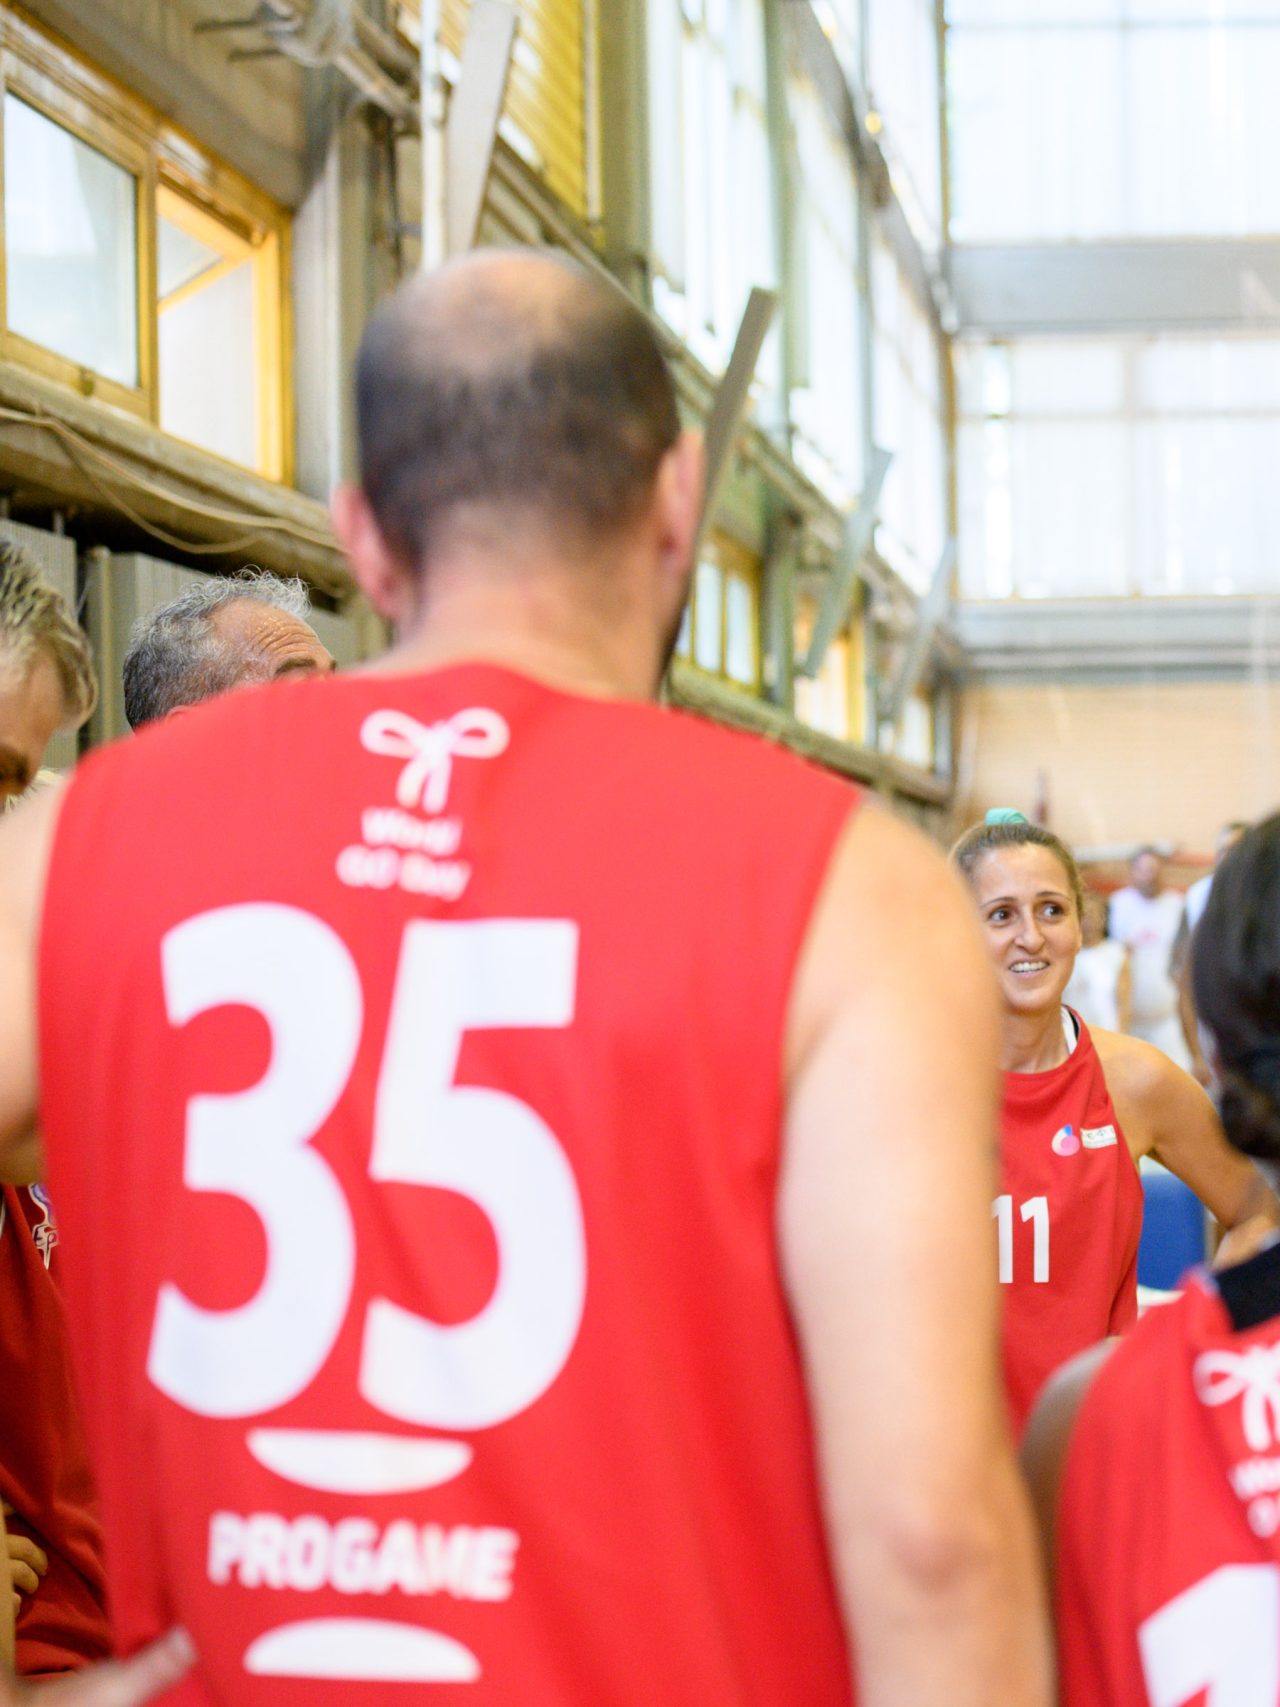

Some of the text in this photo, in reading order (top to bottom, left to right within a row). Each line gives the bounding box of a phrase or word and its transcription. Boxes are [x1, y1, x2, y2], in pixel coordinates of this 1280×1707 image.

[147, 902, 587, 1431] 35
[991, 1194, 1050, 1283] 11
[208, 1511, 520, 1602] PROGAME
